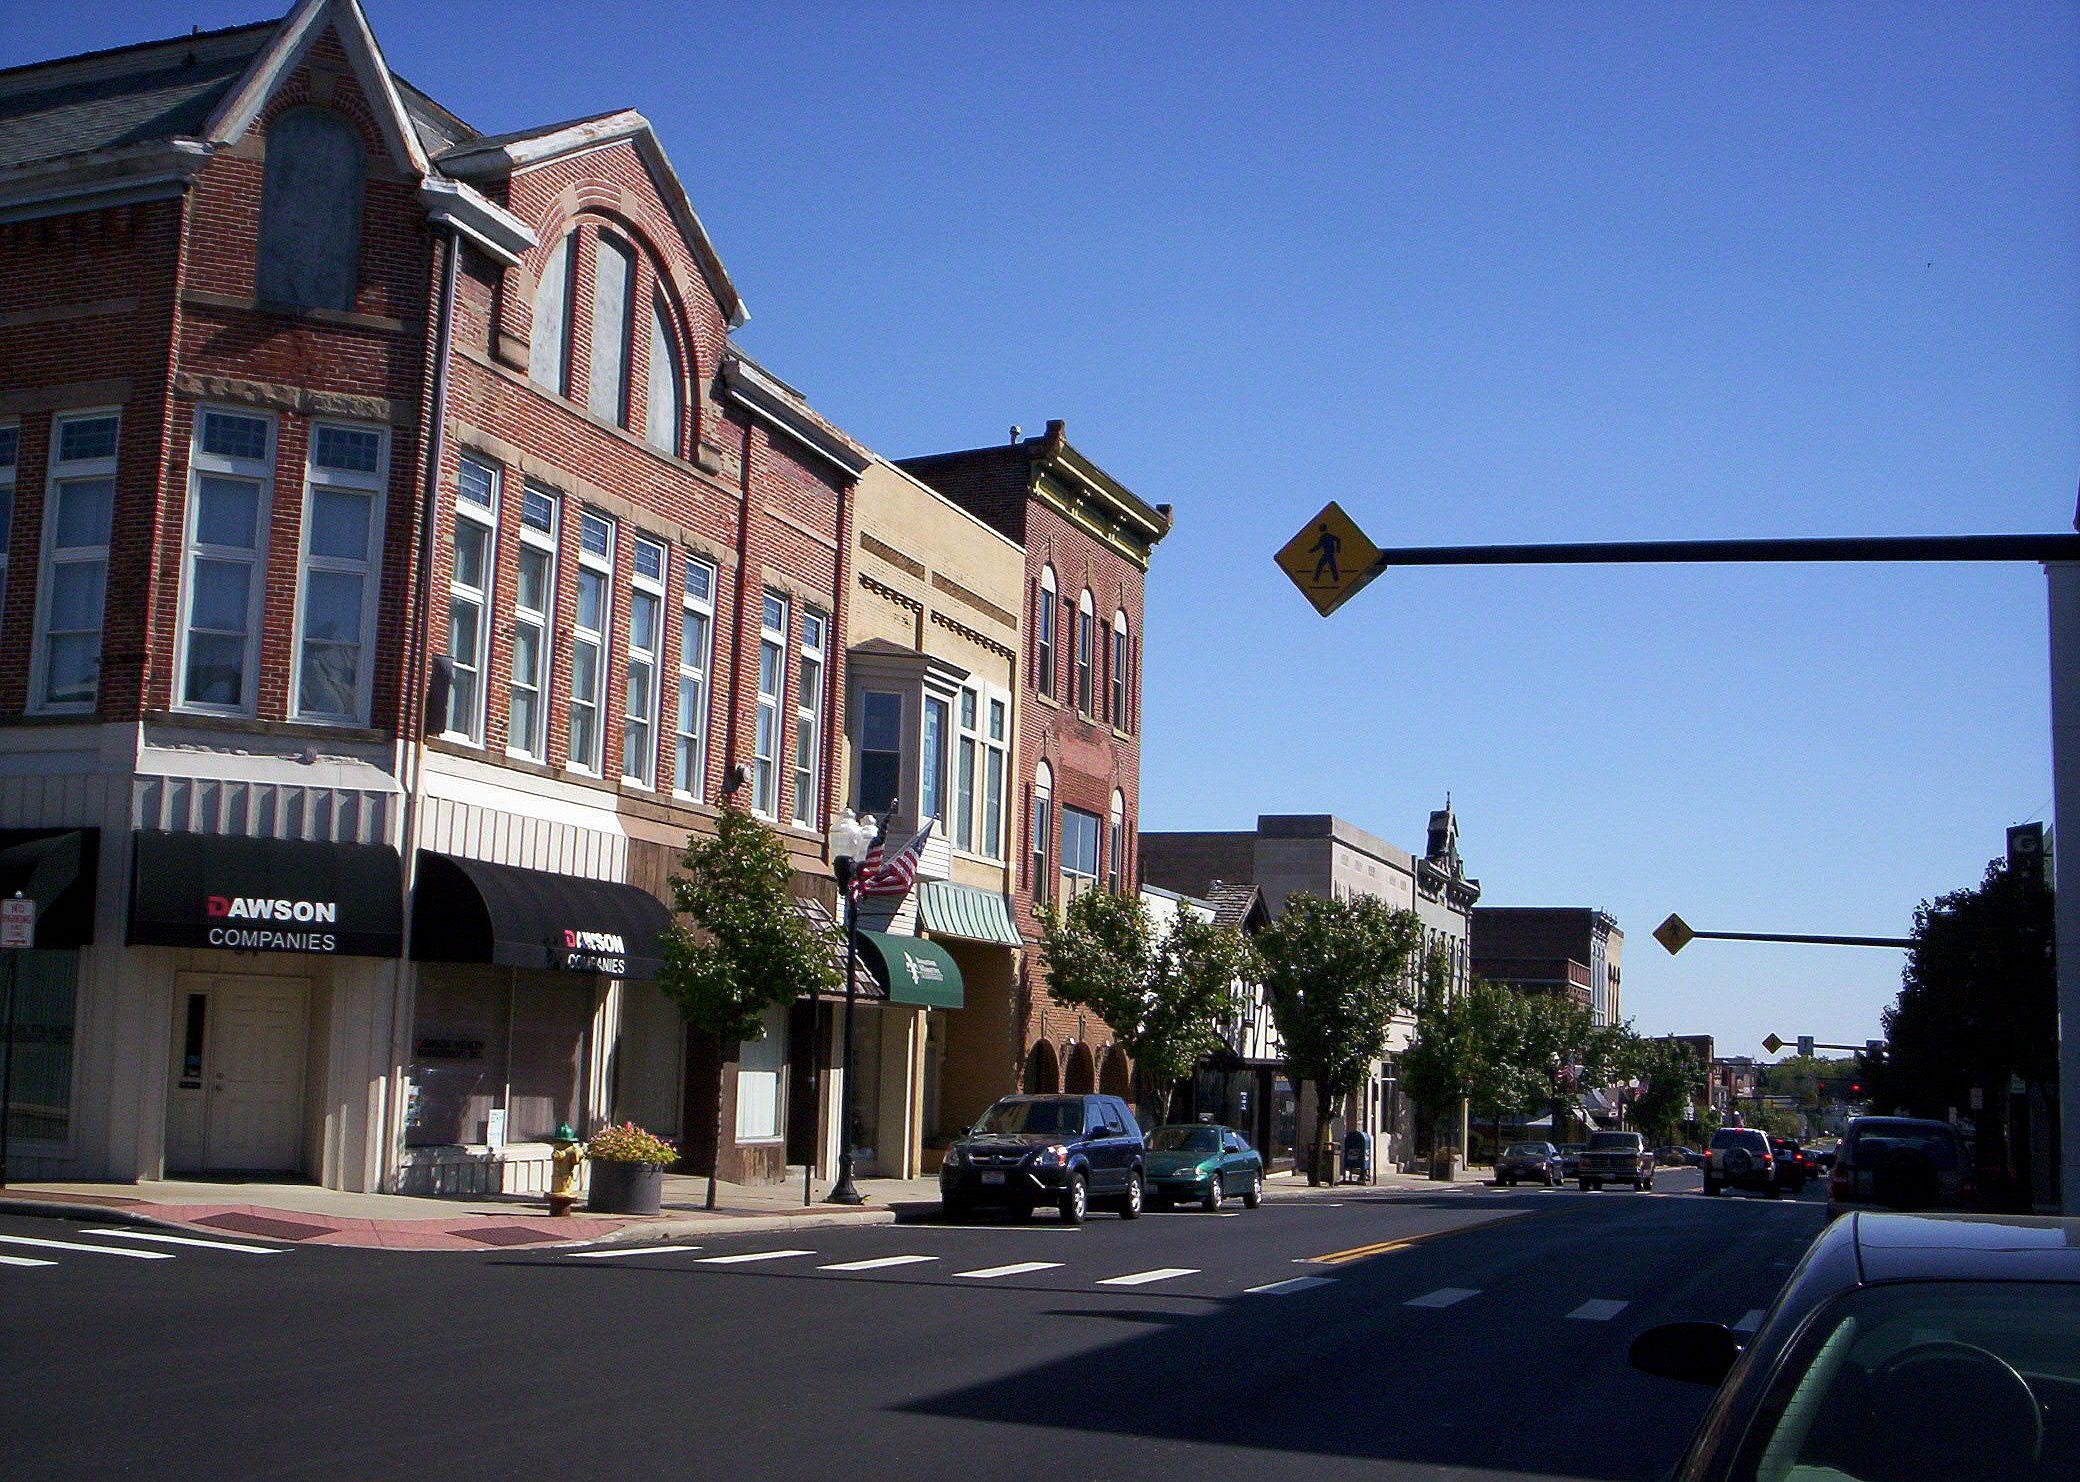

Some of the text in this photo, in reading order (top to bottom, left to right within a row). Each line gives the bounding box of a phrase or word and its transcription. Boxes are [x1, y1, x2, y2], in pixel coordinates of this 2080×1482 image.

[206, 895, 336, 923] DAWSON
[208, 928, 336, 951] COMPANIES
[562, 929, 626, 955] DAWSON
